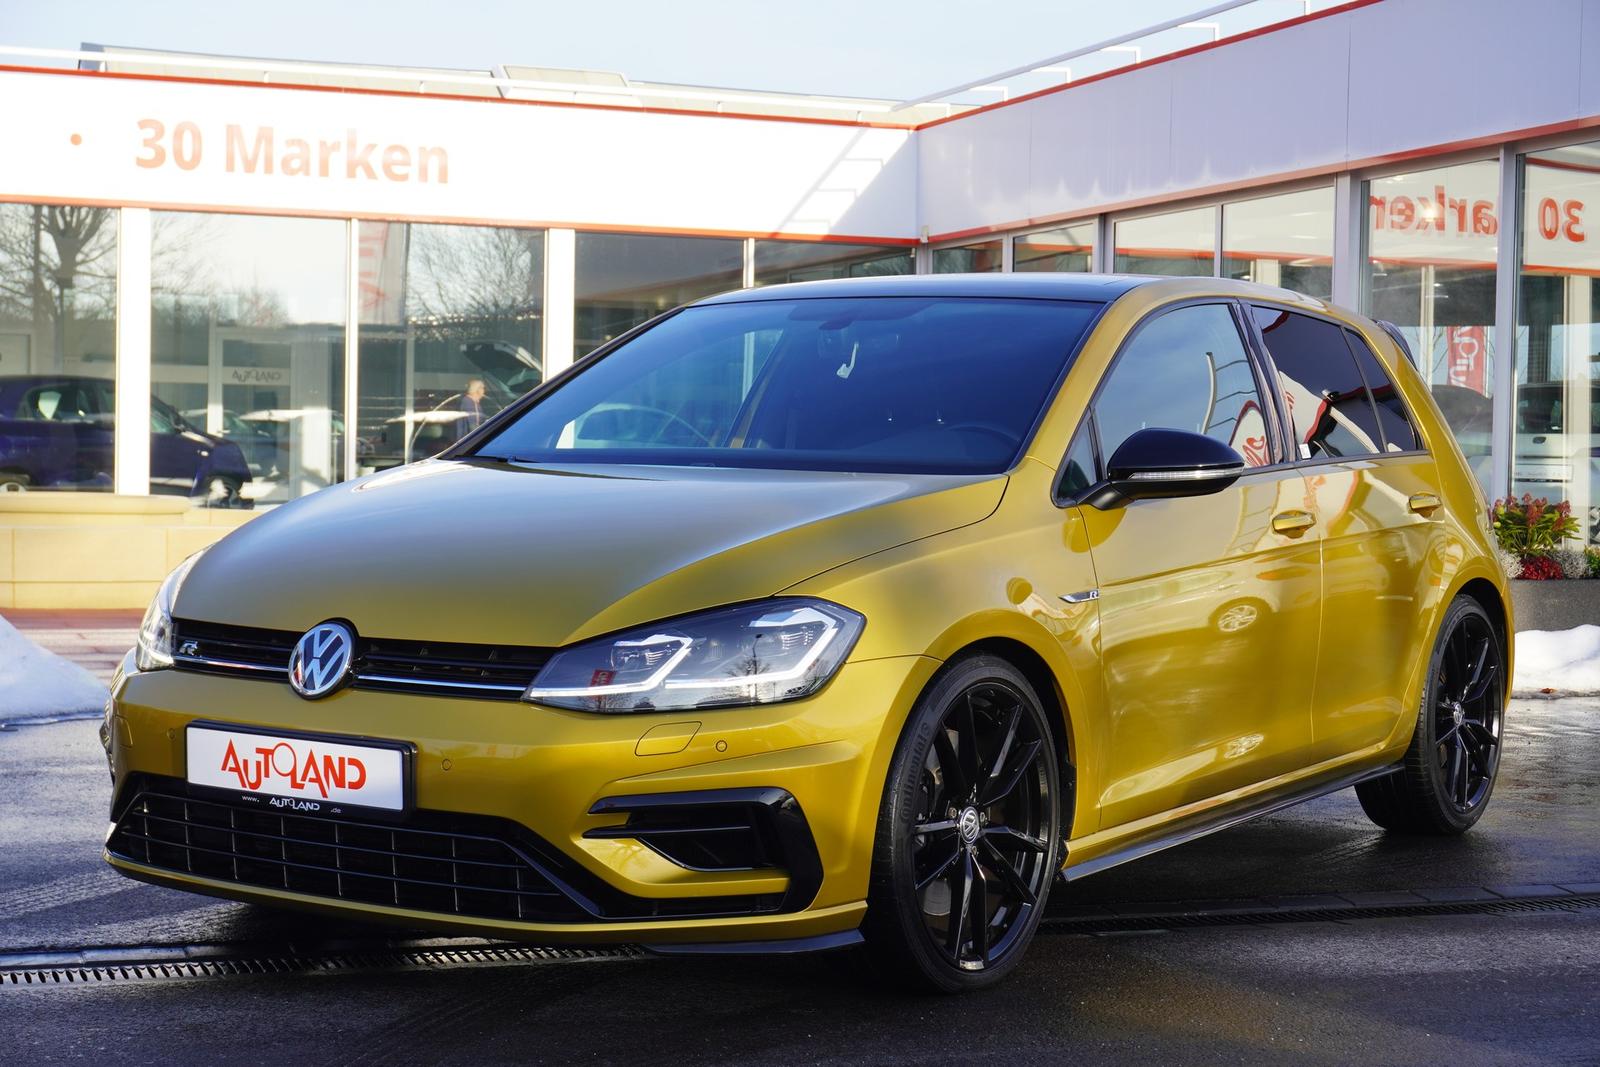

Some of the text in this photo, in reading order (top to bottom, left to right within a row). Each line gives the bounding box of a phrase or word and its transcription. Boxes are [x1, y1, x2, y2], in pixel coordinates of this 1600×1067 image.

[136, 118, 449, 184] 30 Marken
[221, 739, 367, 798] AUTOLAND
[269, 797, 320, 811] AUTOLAND
